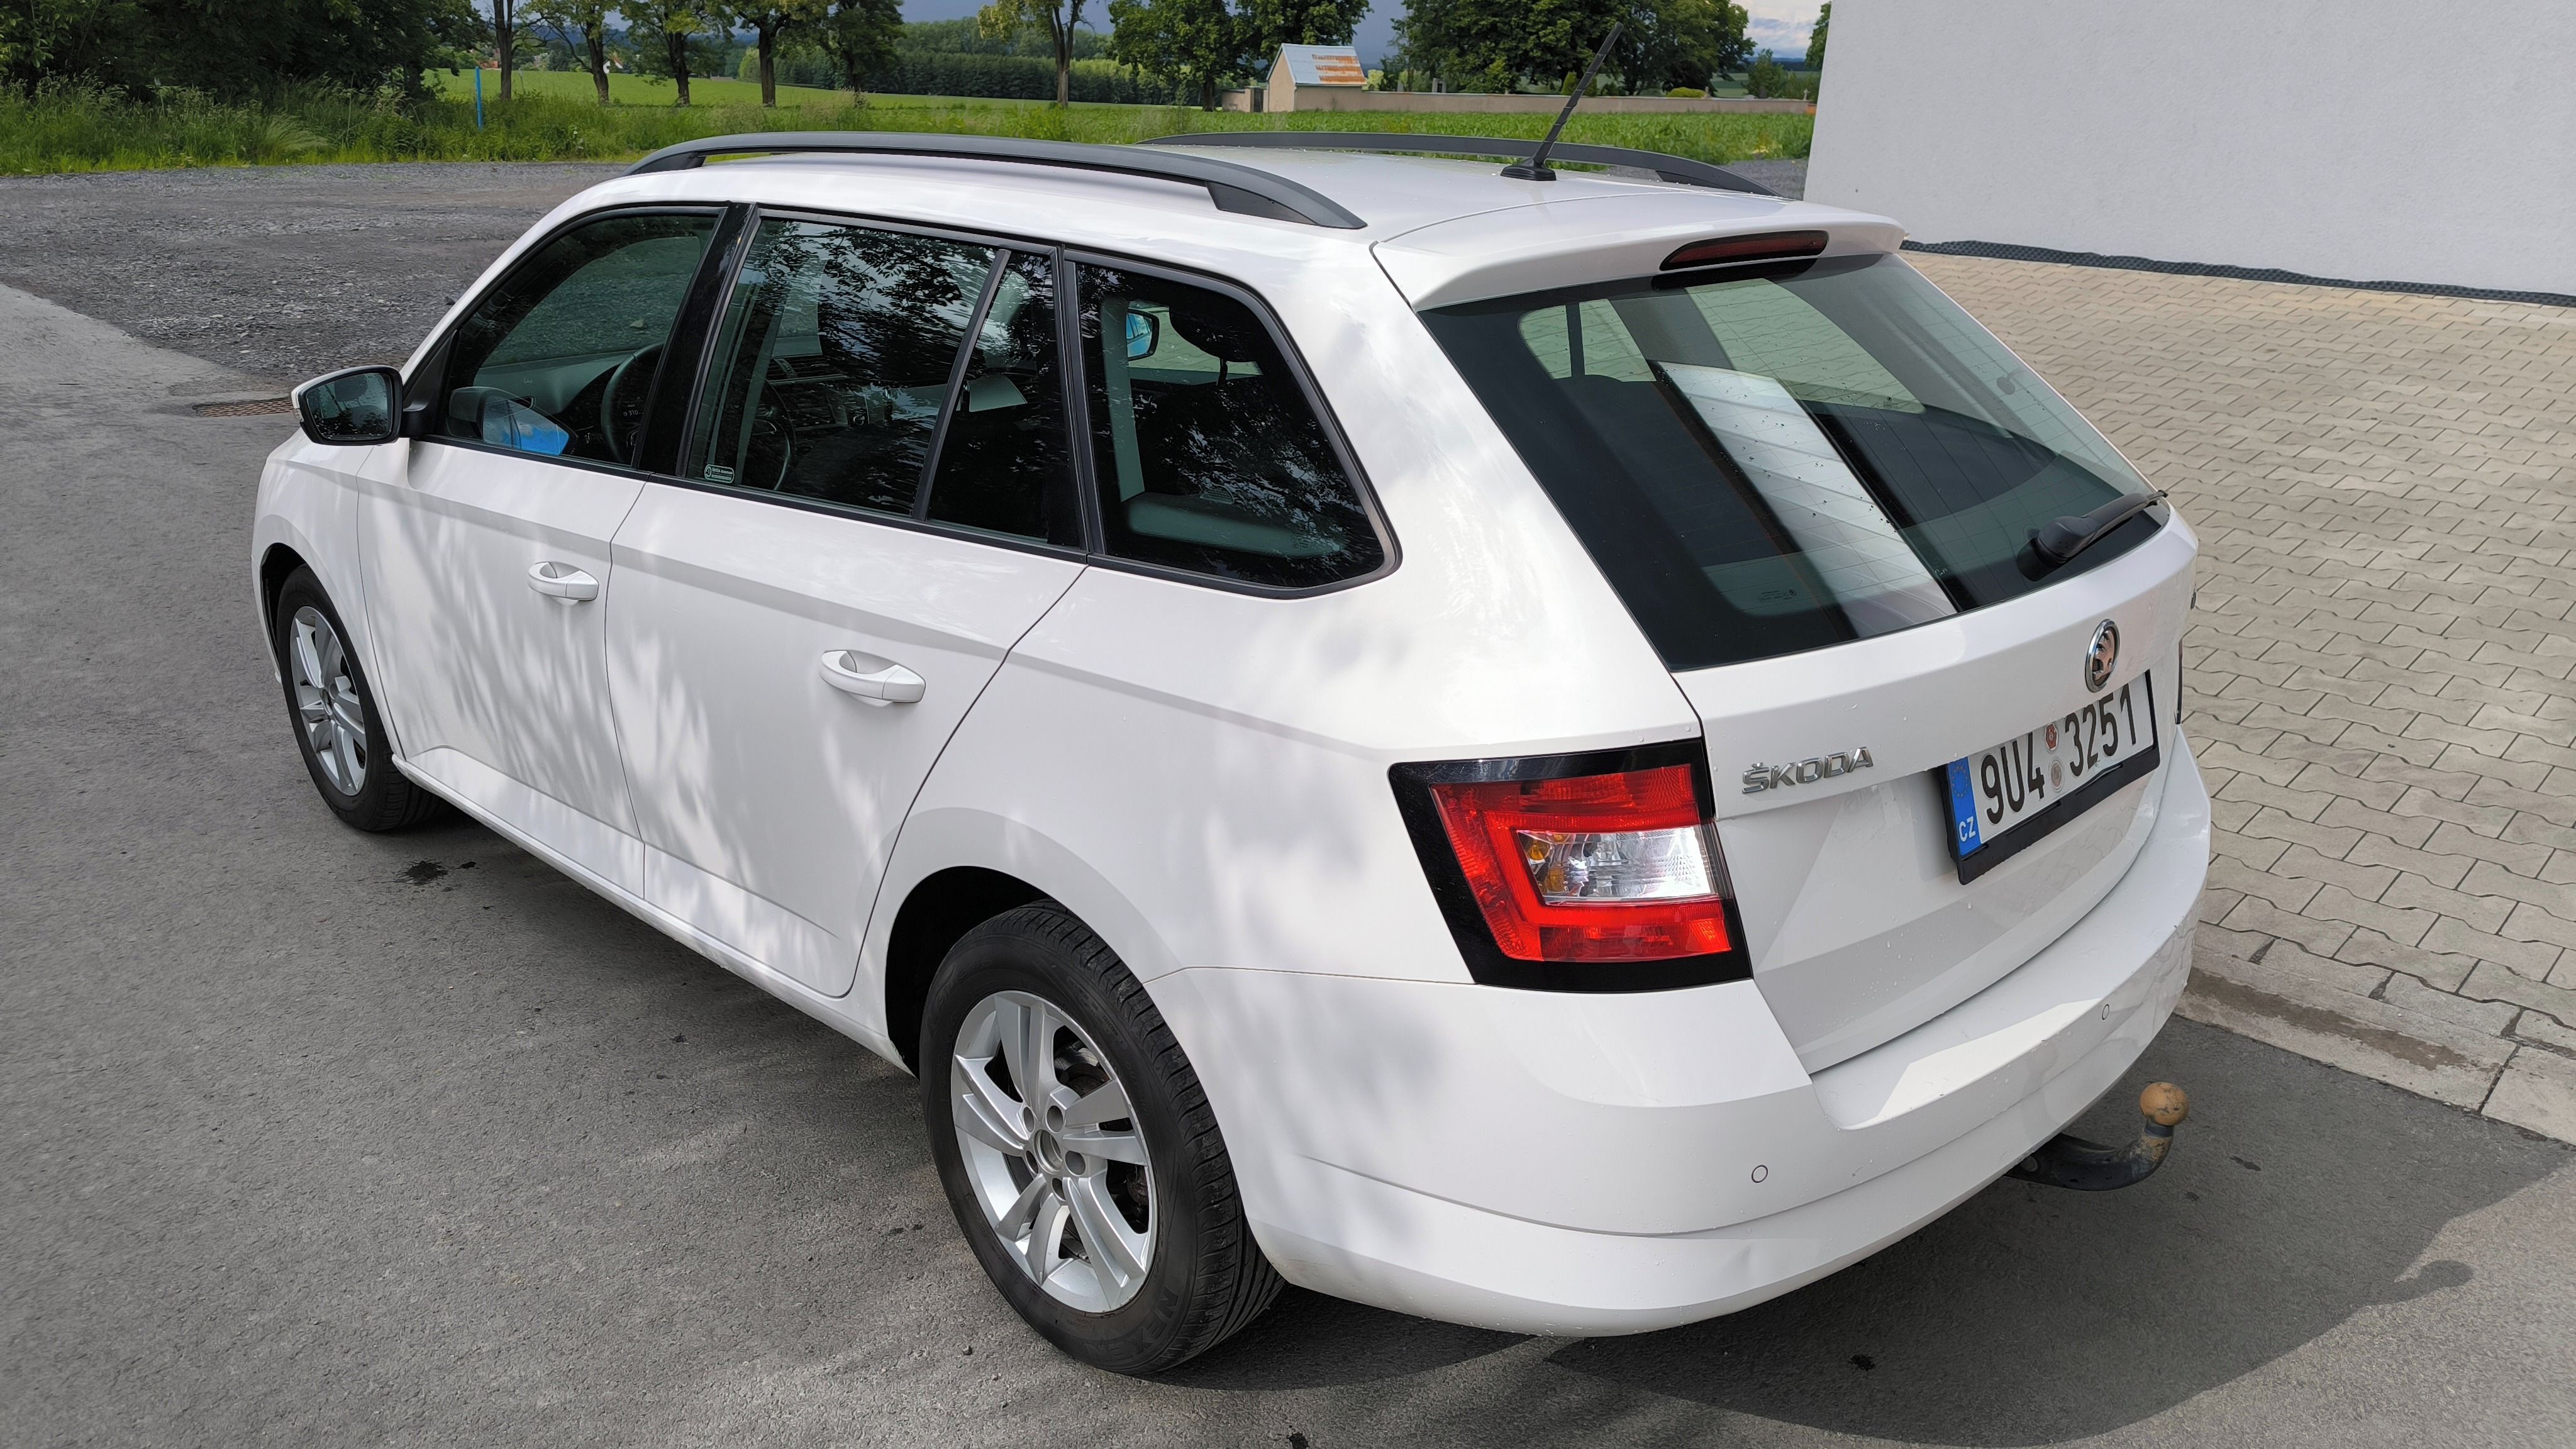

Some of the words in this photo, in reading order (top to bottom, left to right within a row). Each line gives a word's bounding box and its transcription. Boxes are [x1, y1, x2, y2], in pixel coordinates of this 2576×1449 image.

[1742, 747, 1874, 794] ŠKODA
[1981, 731, 2045, 824] 9U4
[2065, 683, 2136, 777] 3251
[1958, 816, 1976, 842] CZ
[1082, 1285, 1179, 1362] NEXEN
